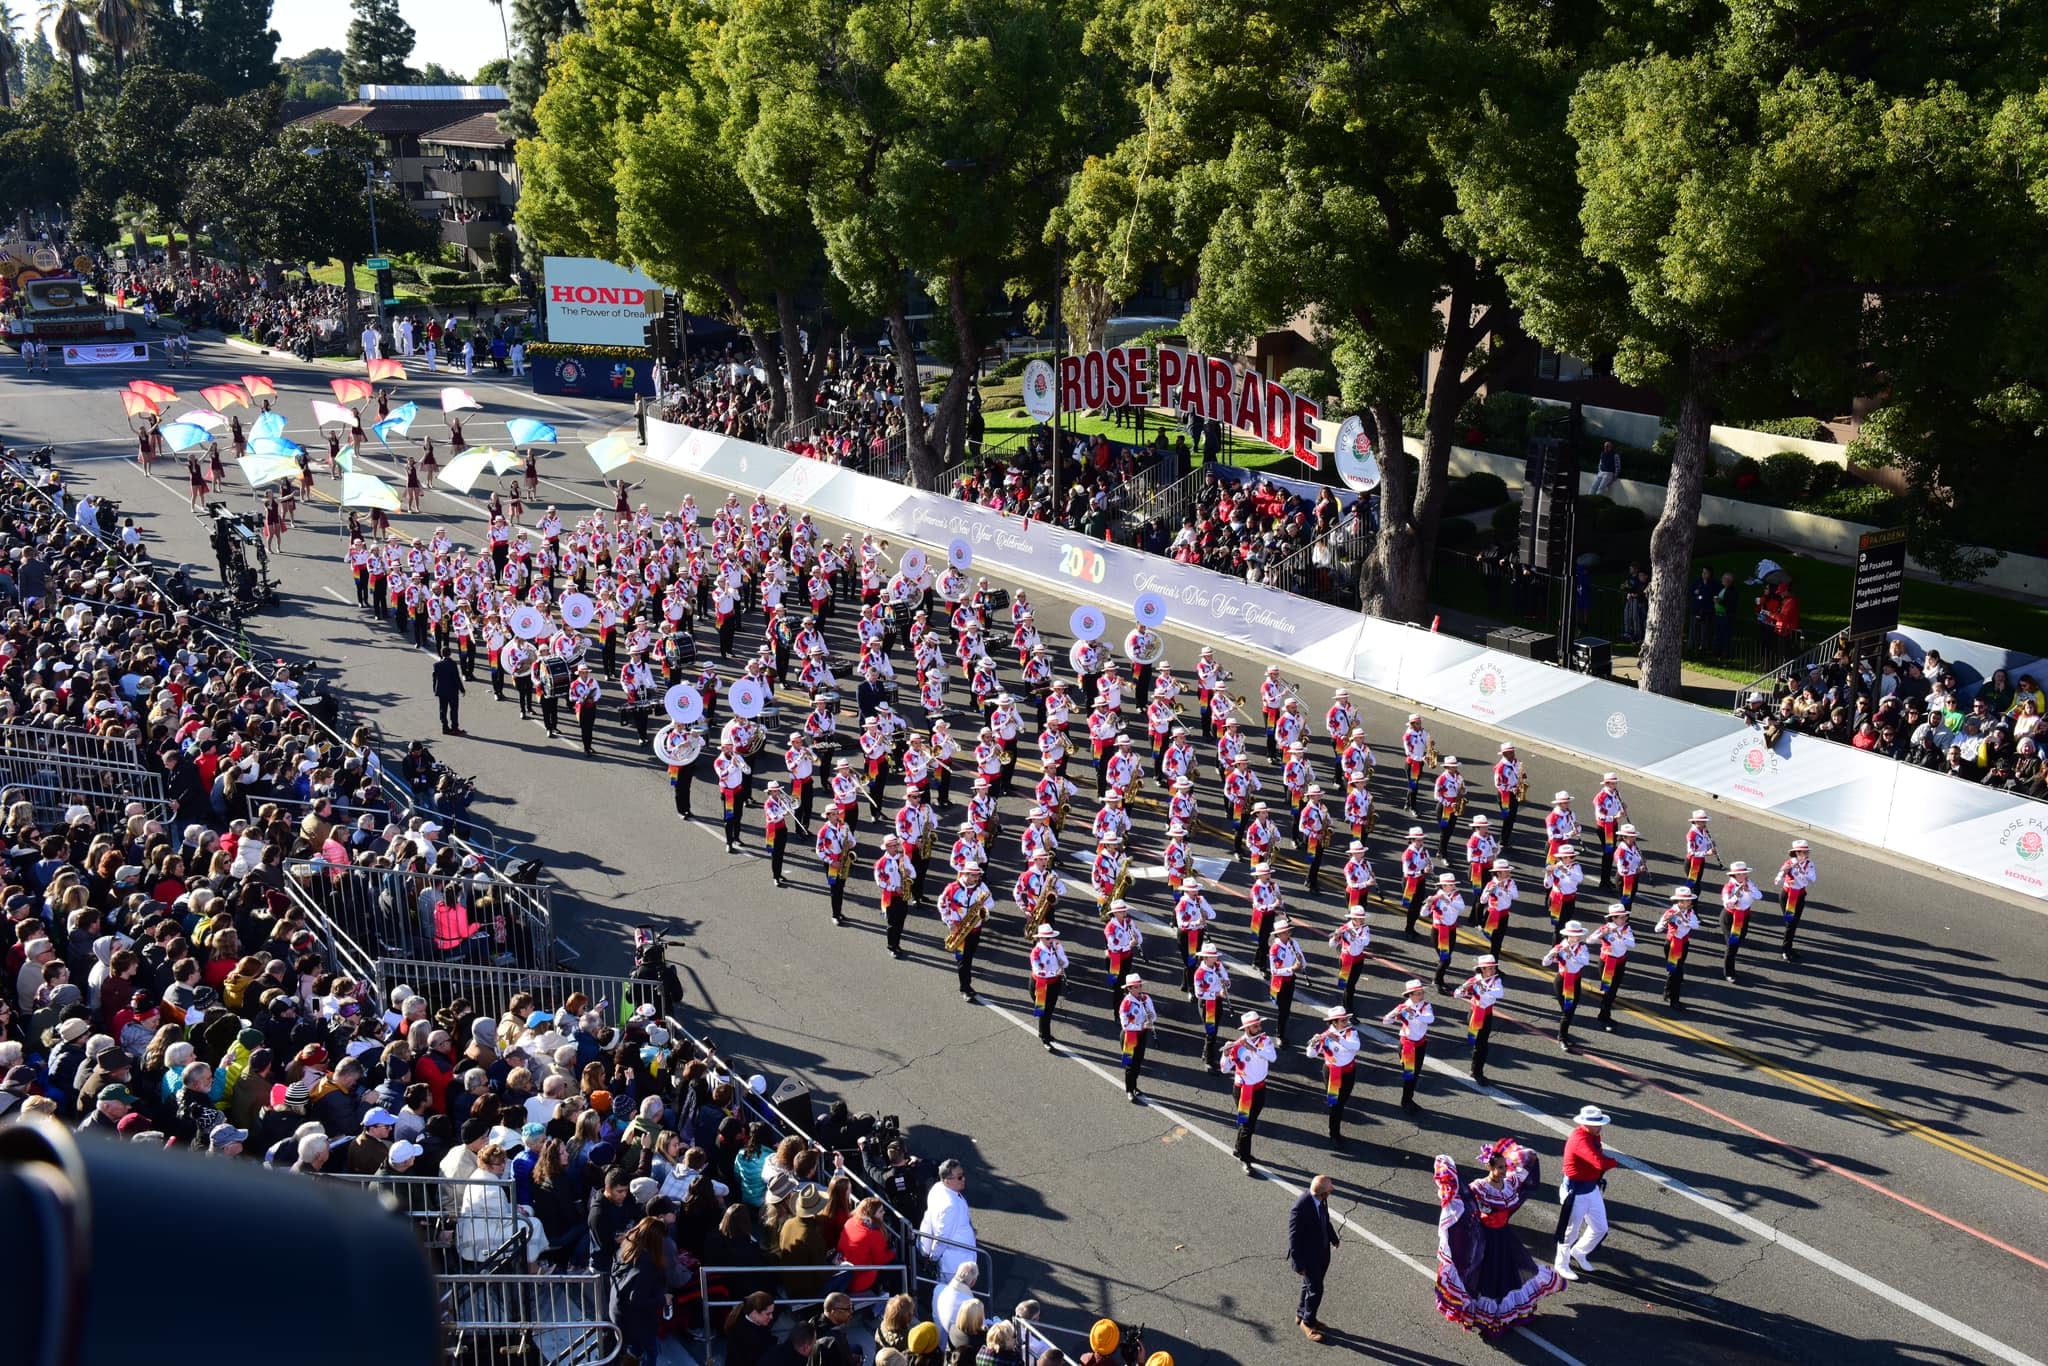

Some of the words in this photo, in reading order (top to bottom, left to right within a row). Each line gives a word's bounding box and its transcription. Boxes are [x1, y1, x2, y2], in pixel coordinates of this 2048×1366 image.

[551, 285, 645, 305] HOND
[561, 307, 578, 315] The
[581, 308, 609, 316] Power
[612, 309, 620, 317] of
[624, 309, 654, 318] Dream
[1060, 347, 1150, 413] ROSE
[1158, 348, 1322, 471] PARADE
[1341, 422, 1356, 451] ROSE
[1347, 474, 1374, 485] HONDA
[1059, 543, 1106, 584] 2020
[1859, 563, 1869, 572] Old
[1869, 560, 1893, 570] Pasadena
[1858, 573, 1885, 585] Convention
[1886, 569, 1902, 579] Center
[1857, 586, 1882, 598] Playhouse
[1883, 582, 1900, 592] District
[1133, 572, 1180, 599] America's
[1181, 585, 1210, 608] New
[1211, 593, 1240, 618] Year
[1241, 602, 1297, 635] Celebration
[1855, 600, 1869, 610] South
[1869, 598, 1881, 607] Lake
[1881, 594, 1899, 604] Avenue
[1469, 663, 1486, 686] ROSE
[1730, 738, 1749, 762] ROSE
[1734, 784, 1764, 797] HONDA
[2000, 818, 2024, 846] ROSE
[2005, 870, 2042, 886] HONDA
